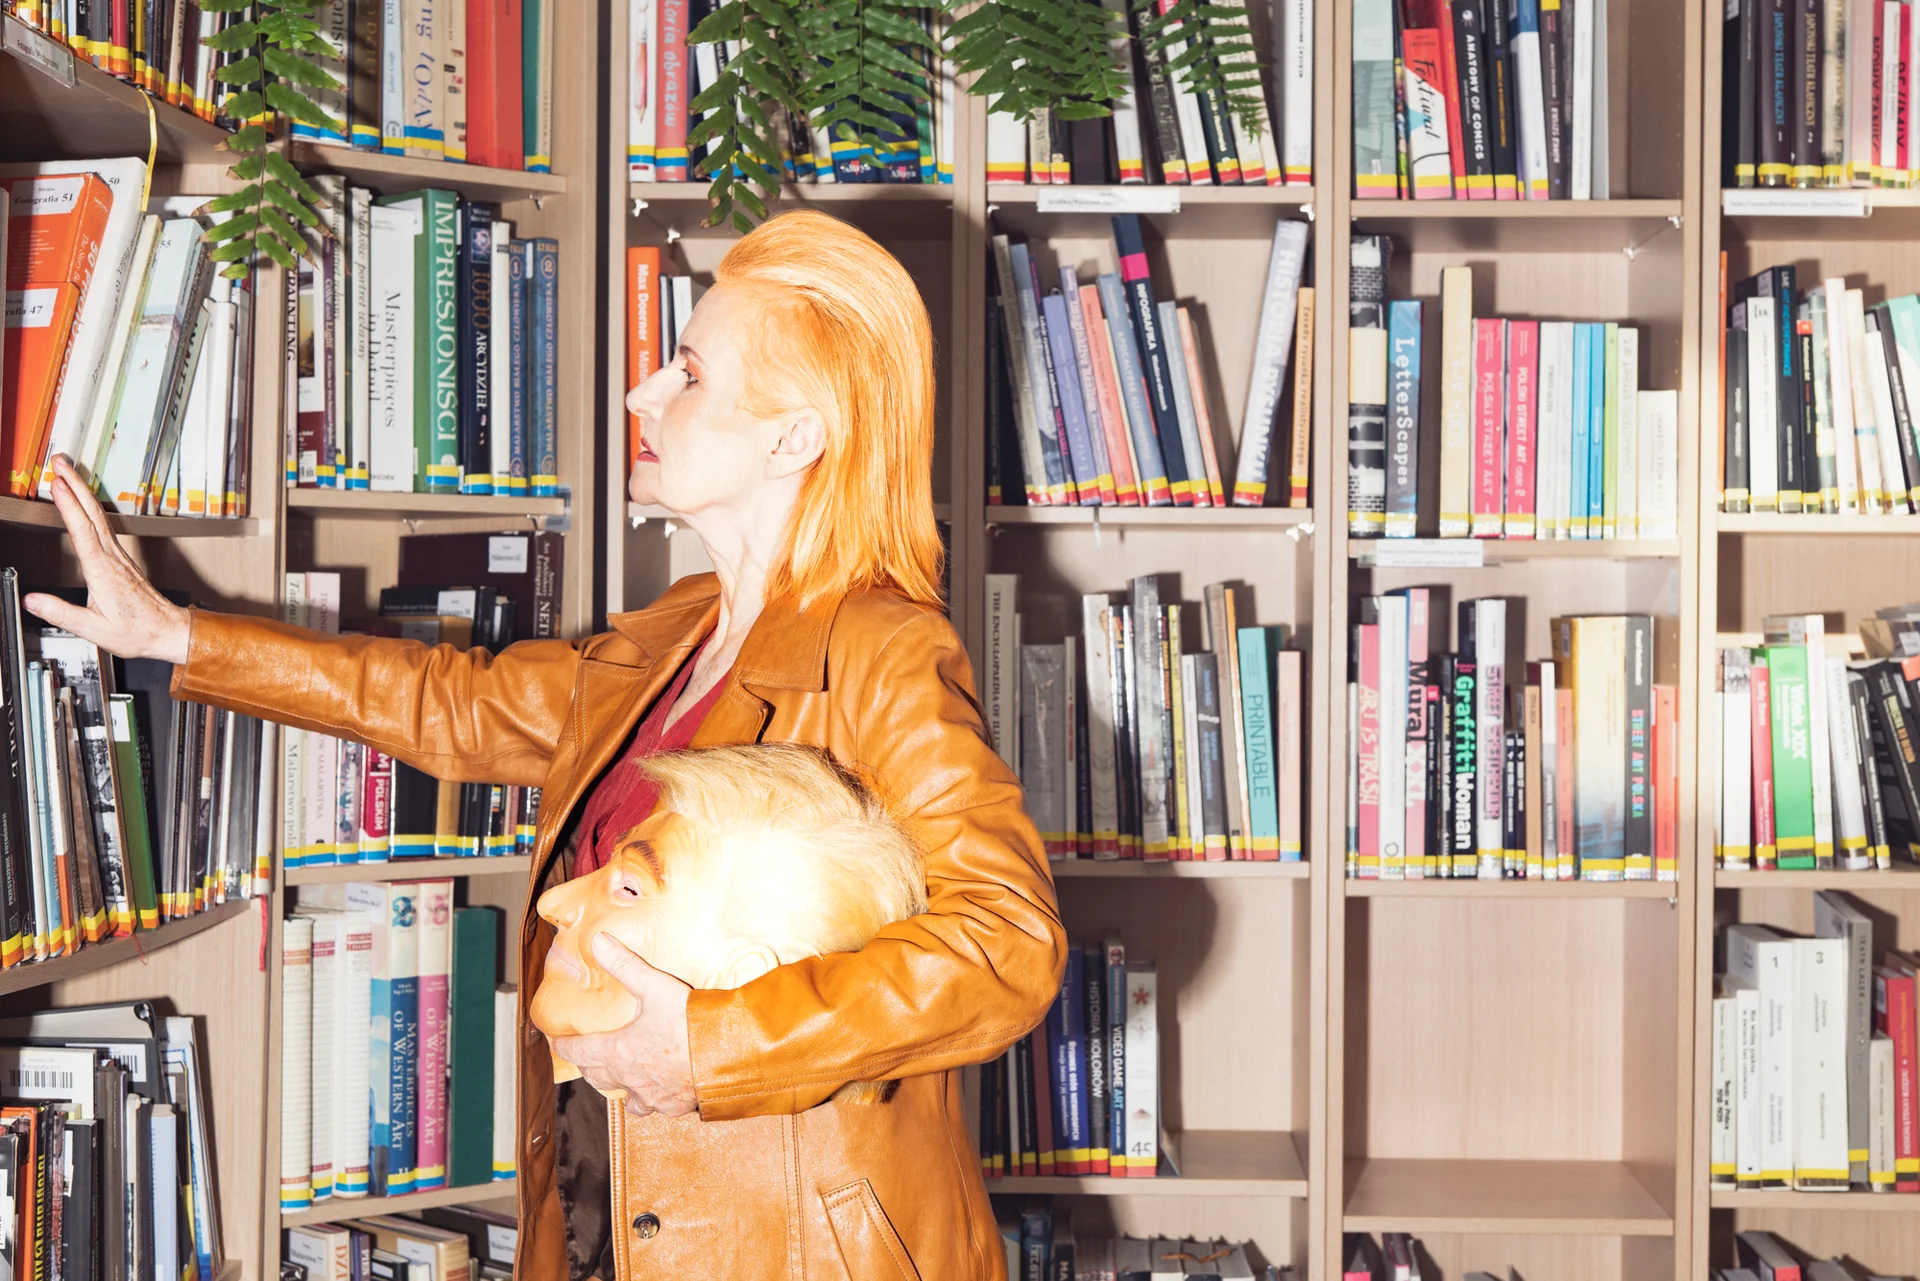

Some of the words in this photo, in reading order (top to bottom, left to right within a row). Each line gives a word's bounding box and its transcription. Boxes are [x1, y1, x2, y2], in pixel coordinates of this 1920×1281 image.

[1466, 34, 1480, 93] ANATOMY
[663, 51, 681, 126] obrazów
[1412, 60, 1441, 139] Festiwal
[1471, 96, 1481, 110] OF
[1472, 112, 1484, 160] COMICS
[14, 196, 59, 206] Fotografia
[61, 193, 74, 201] 51
[108, 178, 120, 186] 50
[75, 249, 86, 270] Story
[88, 241, 99, 264] 50
[544, 260, 554, 273] 2
[325, 279, 334, 303] Color
[637, 263, 649, 290] Max
[30, 306, 43, 314] 47
[472, 269, 491, 329] 1000
[638, 293, 649, 341] Doerner
[1136, 283, 1157, 350] INFOGRAFIKA
[1263, 248, 1297, 358] HISTORIA
[324, 322, 335, 348] Light
[435, 201, 459, 441] IMPRESJONIŚCI
[1300, 306, 1311, 340] Zasady
[384, 290, 401, 428] Masterpieces
[475, 331, 488, 411] ARCYDZIEŁ
[1070, 300, 1089, 365] Imaginative
[1082, 369, 1098, 412] Realism
[1299, 344, 1309, 385] rysunku
[1516, 367, 1527, 401] POLSKI
[513, 391, 521, 454] MALARSTWO
[545, 389, 553, 452] MALARSTWO
[1246, 366, 1280, 478] RYSUNKU
[1297, 389, 1309, 465] realistycznego
[1394, 336, 1416, 485] LetterScapes
[1516, 404, 1527, 441] STREET
[1482, 418, 1494, 465] STREET
[1516, 445, 1527, 463] ART
[1483, 469, 1493, 496] ART
[992, 591, 1001, 613] THE
[992, 615, 1001, 701] ENCYCLOPAEDIA
[992, 703, 1001, 717] OF
[1359, 685, 1379, 718] ART
[1406, 660, 1427, 741] Mural
[1248, 694, 1270, 798] PRINTABLE
[1631, 709, 1645, 748] STREET
[287, 744, 298, 815] Malarstwo
[1631, 752, 1645, 773] ART
[316, 752, 325, 819] MALARSTWA
[375, 778, 386, 830] POLSKIM
[1631, 776, 1645, 818] POLSKA
[2, 812, 10, 854] FOTOGRAFII
[284, 820, 297, 848] pols
[5, 856, 14, 906] PRZESTRZENIE
[1815, 952, 1824, 964] 3
[394, 1010, 404, 1031] OF
[426, 1008, 436, 1028] OF
[1089, 981, 1100, 1033] HISTORIA
[1113, 1026, 1123, 1056] VIDEO
[391, 1035, 406, 1114] WESTERN
[424, 1032, 438, 1110] WESTERN
[1091, 1038, 1104, 1098] KOLORÓW
[1113, 1058, 1123, 1088] GAME
[1113, 1089, 1123, 1109] ART
[391, 1120, 406, 1151] ART
[424, 1115, 438, 1146] ART
